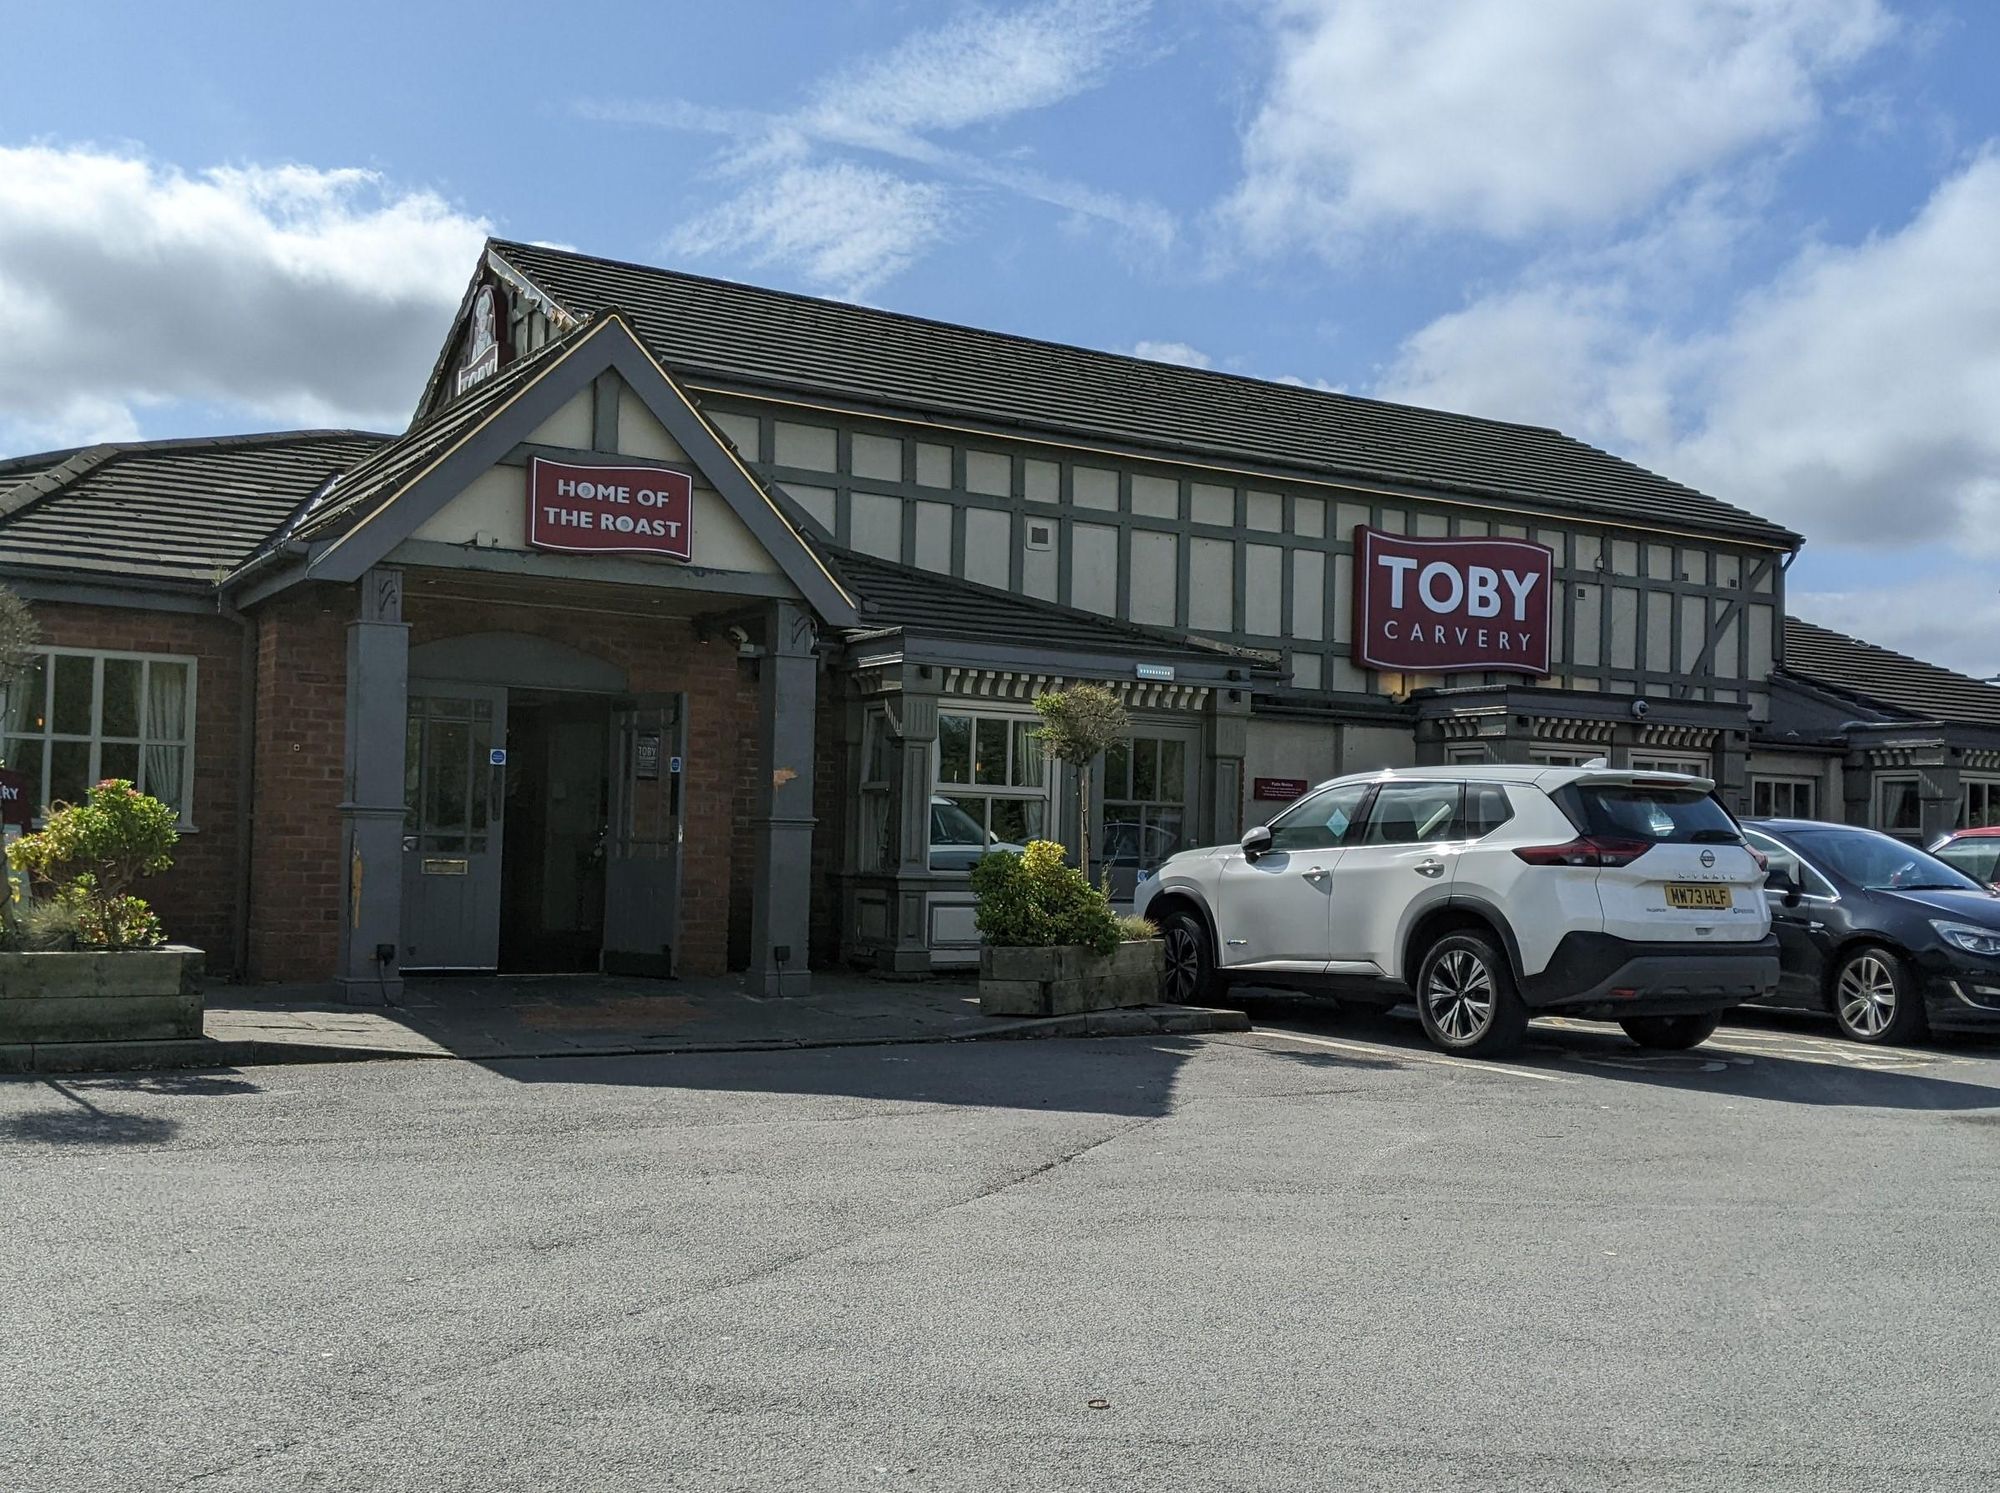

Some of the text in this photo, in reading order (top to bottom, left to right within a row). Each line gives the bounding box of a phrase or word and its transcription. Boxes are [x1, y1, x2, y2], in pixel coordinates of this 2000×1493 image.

[557, 479, 669, 508] HOME OF
[543, 507, 682, 539] THE ROAST
[1378, 554, 1540, 622] TOBY
[1384, 620, 1531, 651] CARVERY
[0, 786, 19, 800] RY
[1704, 889, 1726, 905] HLF
